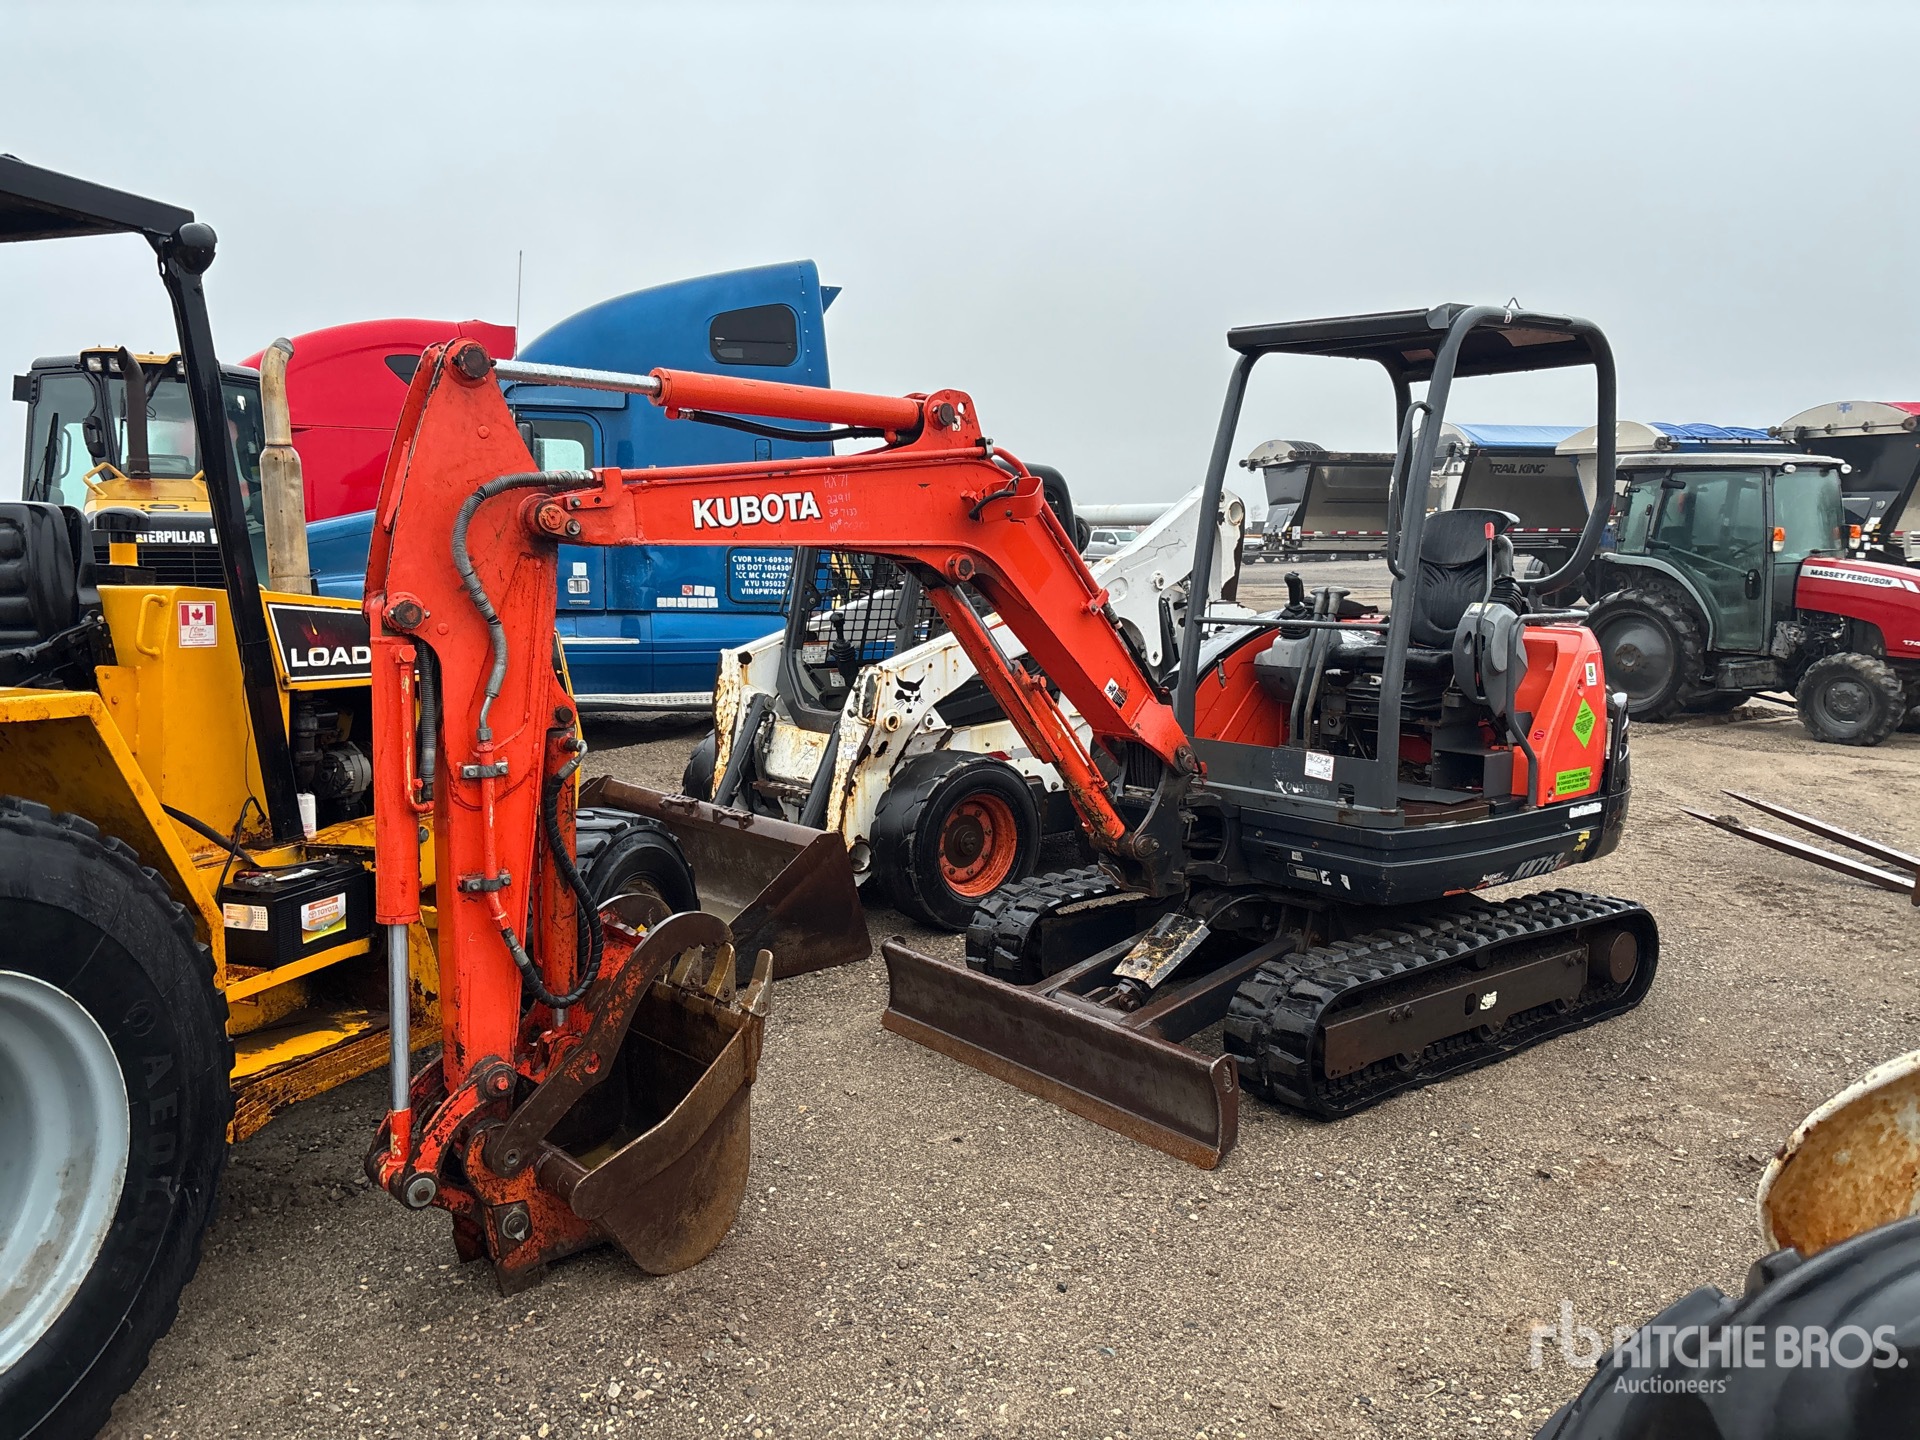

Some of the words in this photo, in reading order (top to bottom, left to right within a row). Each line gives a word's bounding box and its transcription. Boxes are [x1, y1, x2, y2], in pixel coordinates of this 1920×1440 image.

[1489, 463, 1517, 474] TRAIL
[1518, 463, 1545, 474] KING
[691, 491, 821, 529] KUBOTA
[136, 531, 206, 543] ATERPILLAR
[1810, 569, 1845, 579] MASSEY
[1846, 573, 1893, 586] FERGUSON
[290, 646, 372, 668] LOAD
[318, 904, 338, 915] TOYOTA
